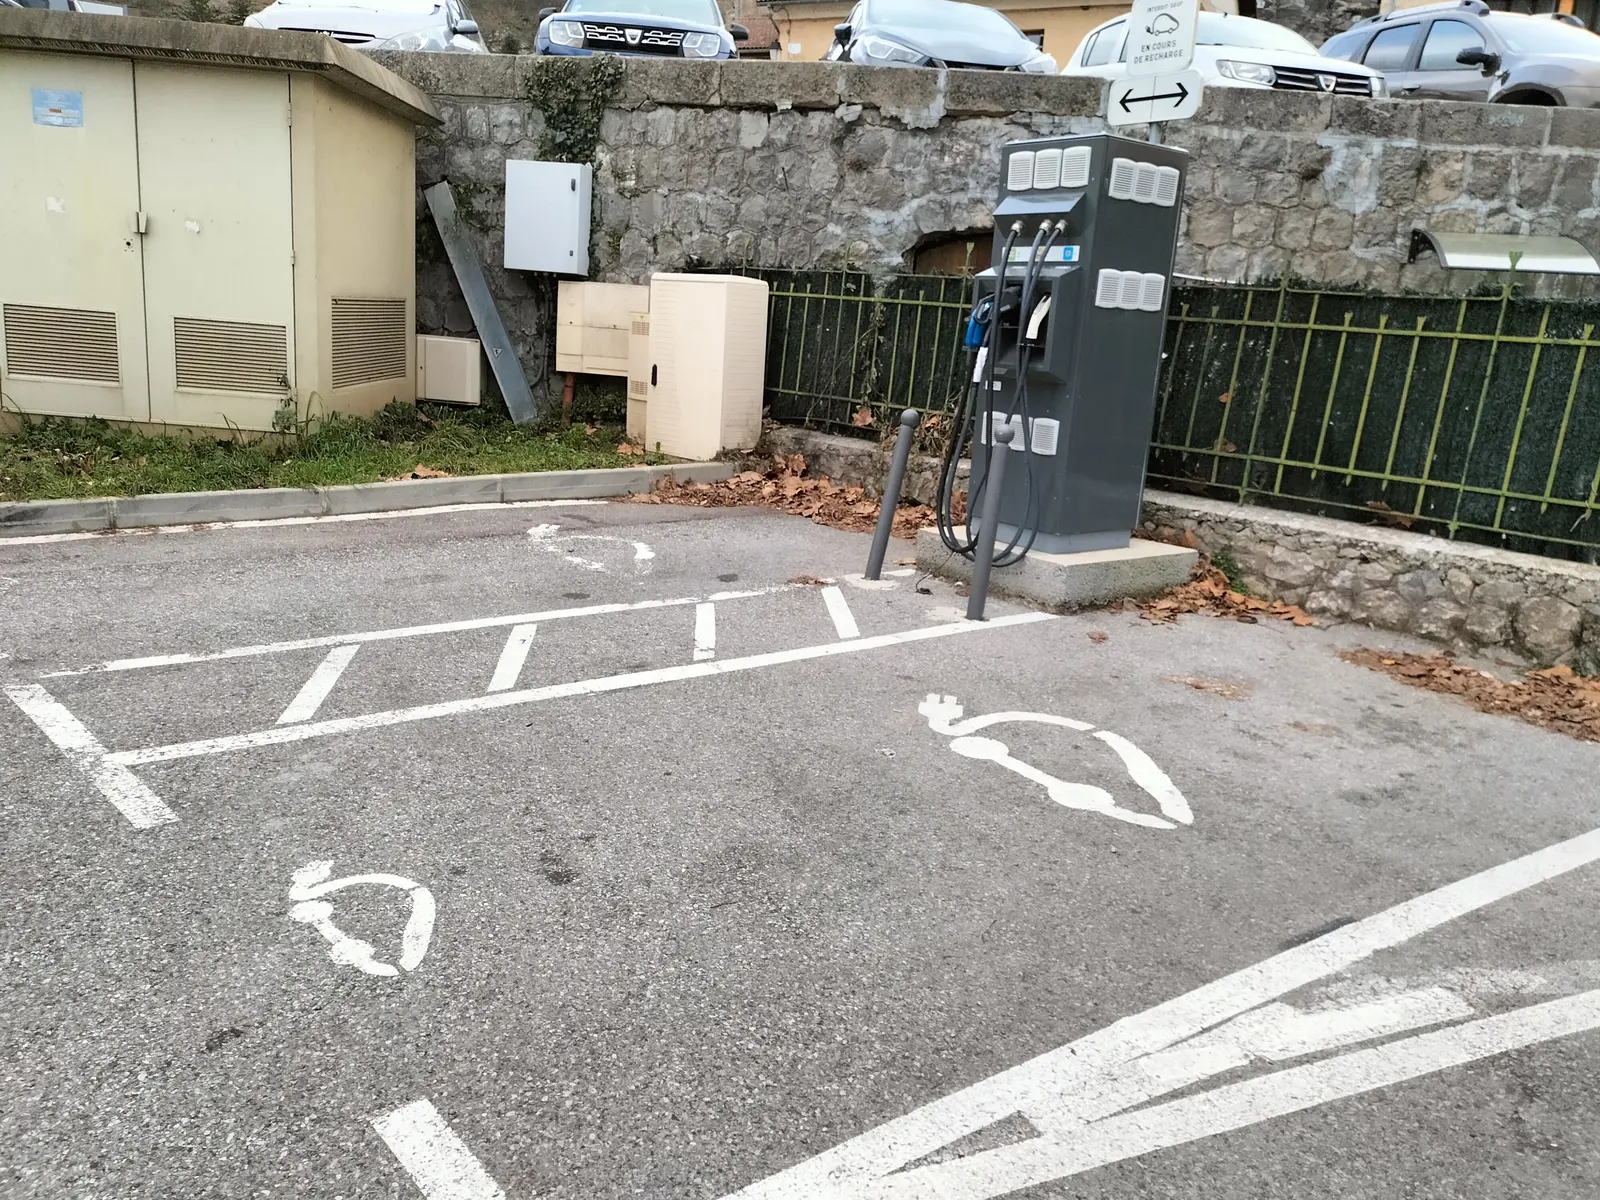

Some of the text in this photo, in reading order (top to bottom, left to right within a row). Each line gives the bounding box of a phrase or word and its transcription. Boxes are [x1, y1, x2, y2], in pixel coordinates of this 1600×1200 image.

[1141, 40, 1177, 52] EN COURS
[1134, 49, 1184, 64] DE RECHARGE
